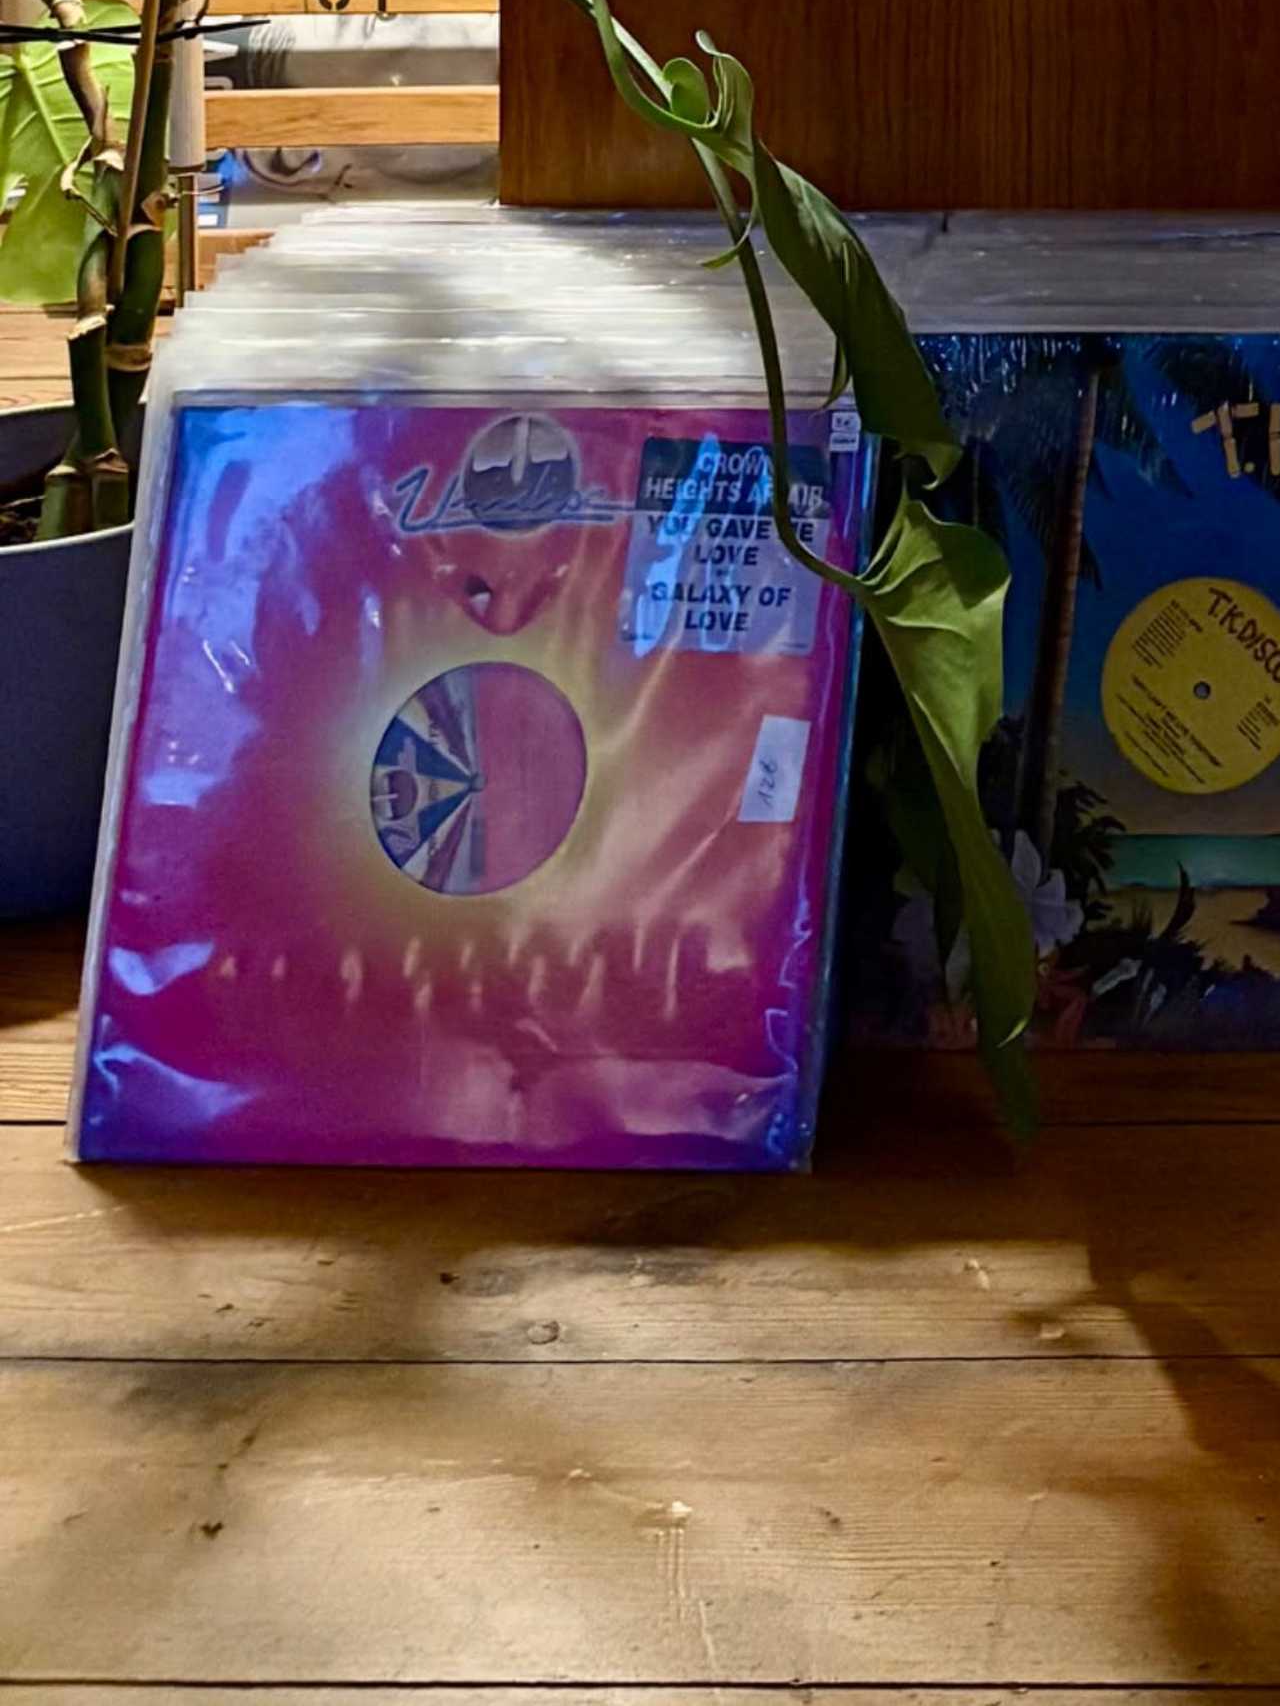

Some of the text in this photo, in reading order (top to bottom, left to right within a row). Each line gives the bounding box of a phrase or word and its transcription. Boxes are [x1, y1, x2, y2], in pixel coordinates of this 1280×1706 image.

[644, 475, 743, 505] HEIGHTS
[706, 517, 772, 540] GAVE
[693, 544, 760, 566] LOVE
[651, 579, 792, 608] GALAXY OF
[684, 609, 750, 632] LOVE
